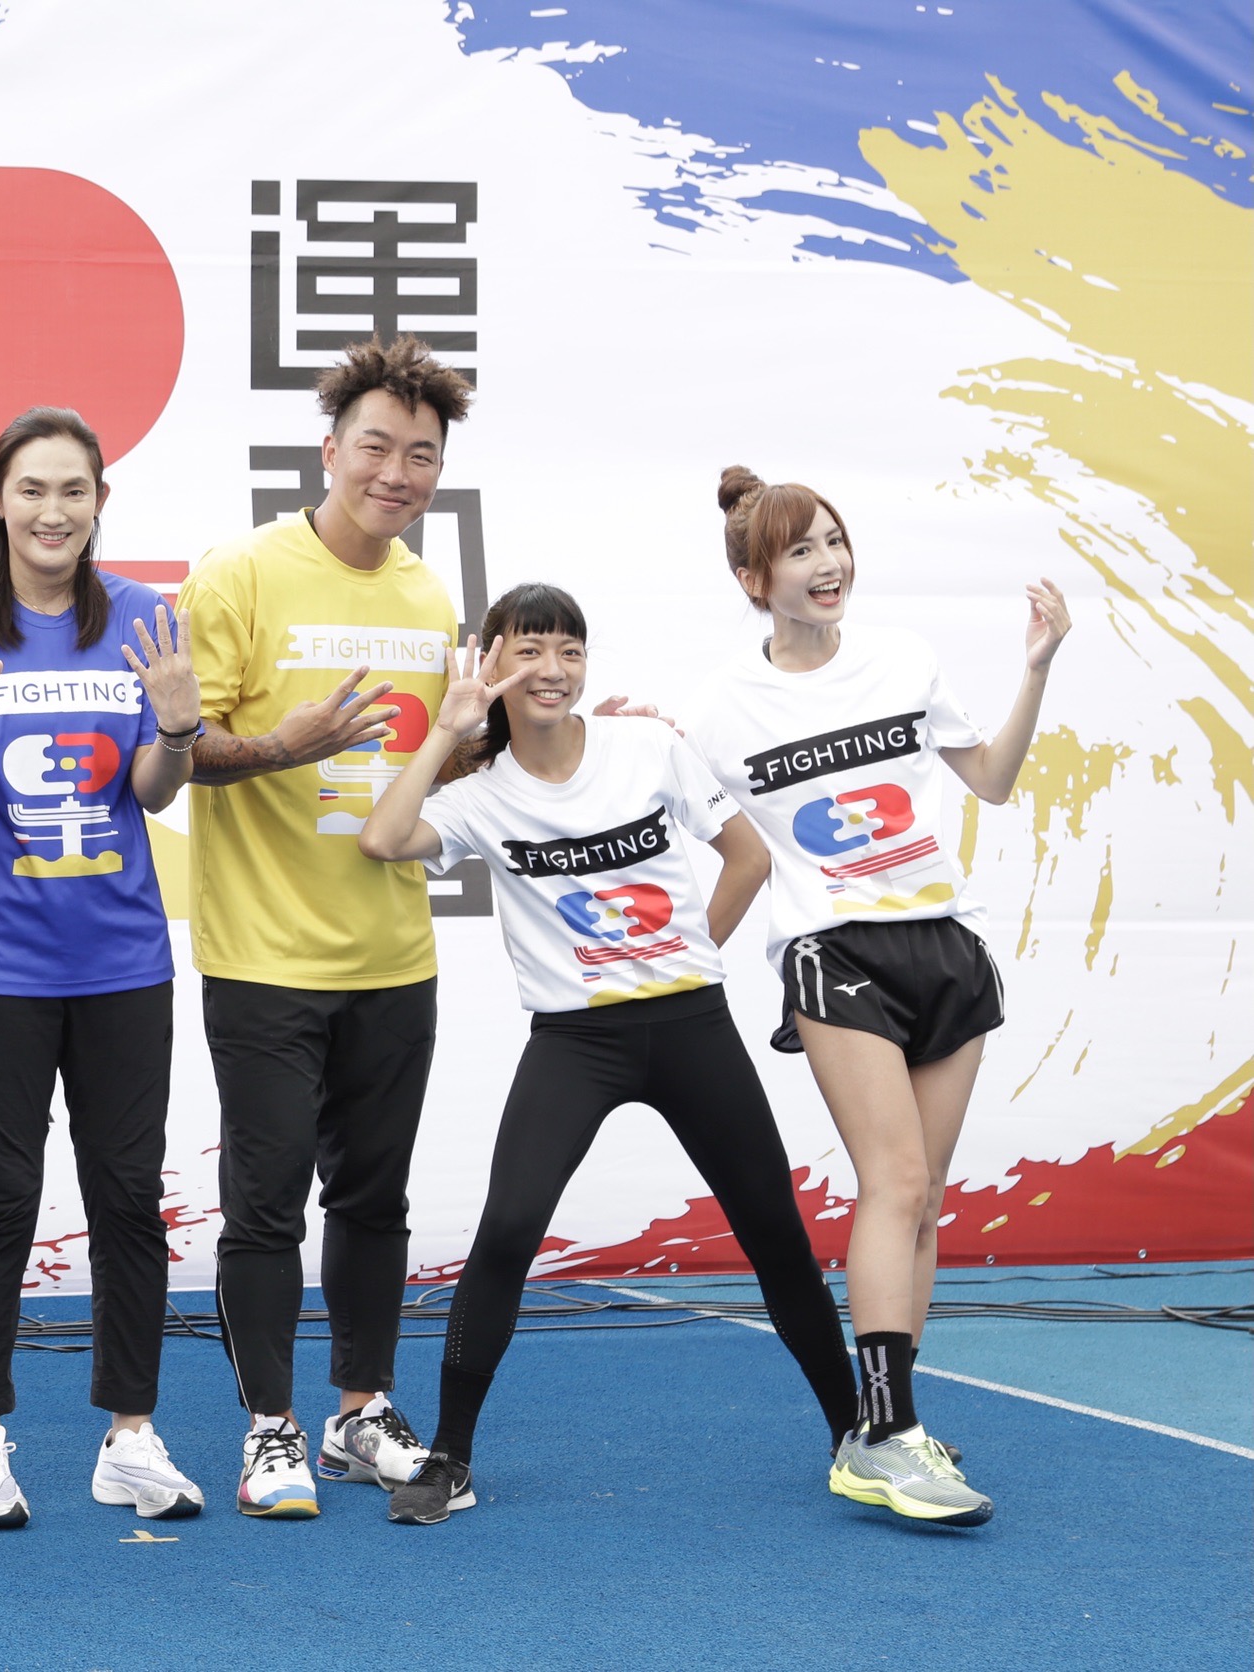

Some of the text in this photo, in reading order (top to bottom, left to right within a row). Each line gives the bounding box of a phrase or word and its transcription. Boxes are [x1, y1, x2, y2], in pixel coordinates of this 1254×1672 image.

[312, 637, 436, 662] FIGHTING
[766, 726, 908, 782] FIGHTING
[526, 827, 658, 871] FIGHTING
